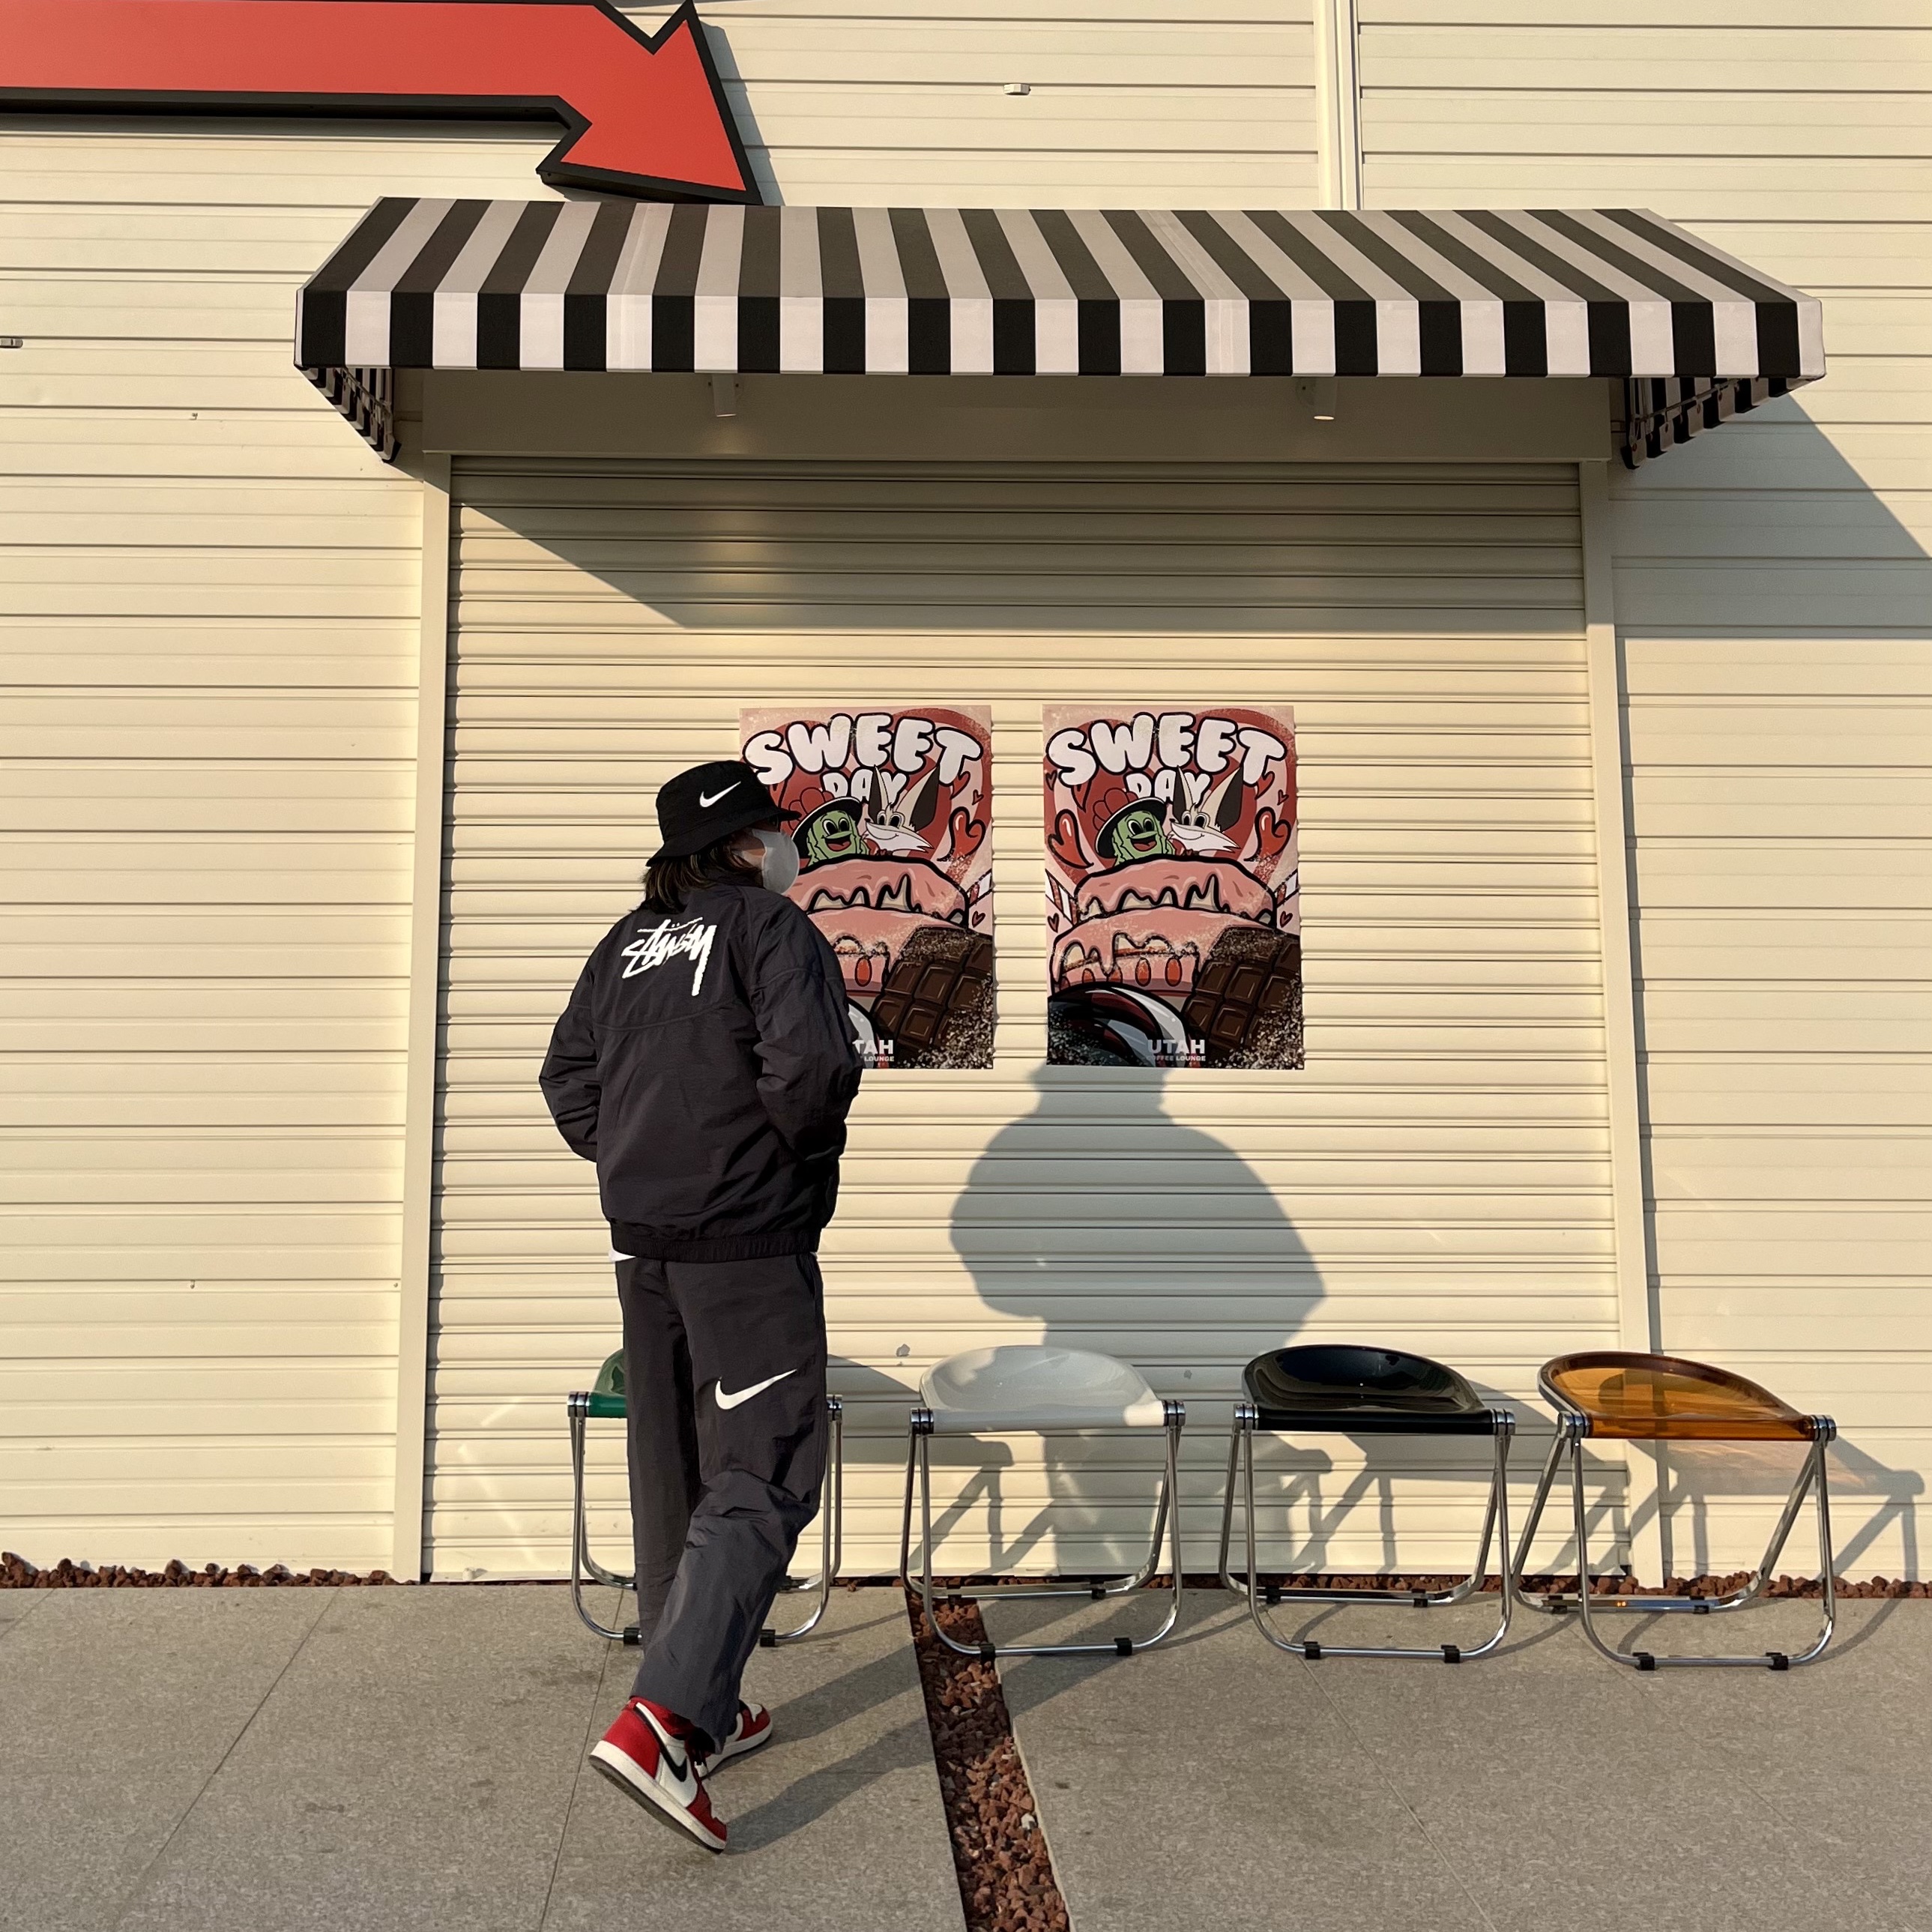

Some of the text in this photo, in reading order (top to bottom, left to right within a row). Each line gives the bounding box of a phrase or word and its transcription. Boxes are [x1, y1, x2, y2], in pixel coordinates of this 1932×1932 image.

[743, 713, 984, 785] SWEET
[1046, 713, 1287, 786] SWEET
[822, 770, 907, 805] DAY
[1126, 770, 1212, 805] DAY
[852, 1039, 893, 1054] TAH
[1147, 1039, 1205, 1054] UTAH
